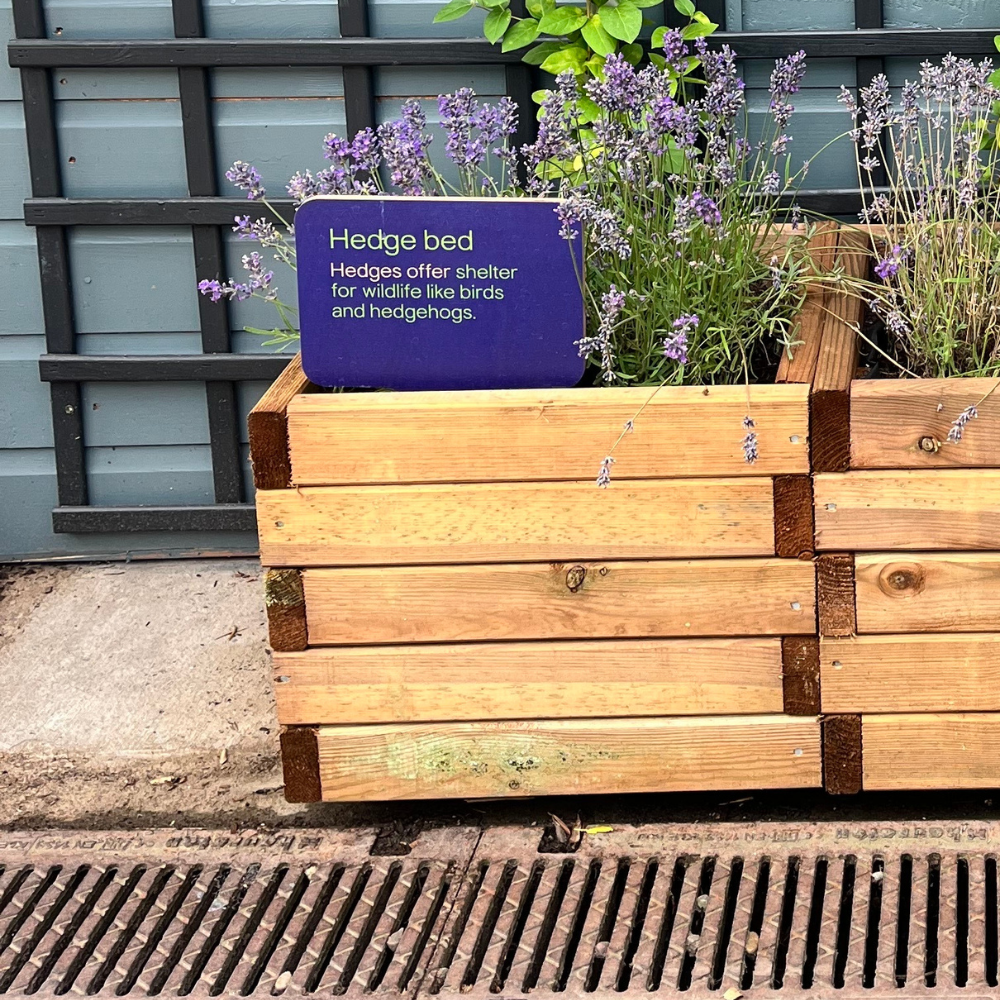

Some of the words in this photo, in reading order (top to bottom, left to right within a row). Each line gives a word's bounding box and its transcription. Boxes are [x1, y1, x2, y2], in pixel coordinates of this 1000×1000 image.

[329, 228, 416, 256] Hedge
[424, 230, 474, 252] bed
[330, 262, 402, 282] Hedges
[407, 263, 451, 279] offer
[456, 264, 518, 279] shelter
[331, 283, 357, 298] for
[363, 284, 421, 299] wildlife
[427, 284, 456, 299] like
[460, 284, 504, 299] birds
[332, 304, 365, 318] and
[370, 304, 476, 323] hedgehogs.
